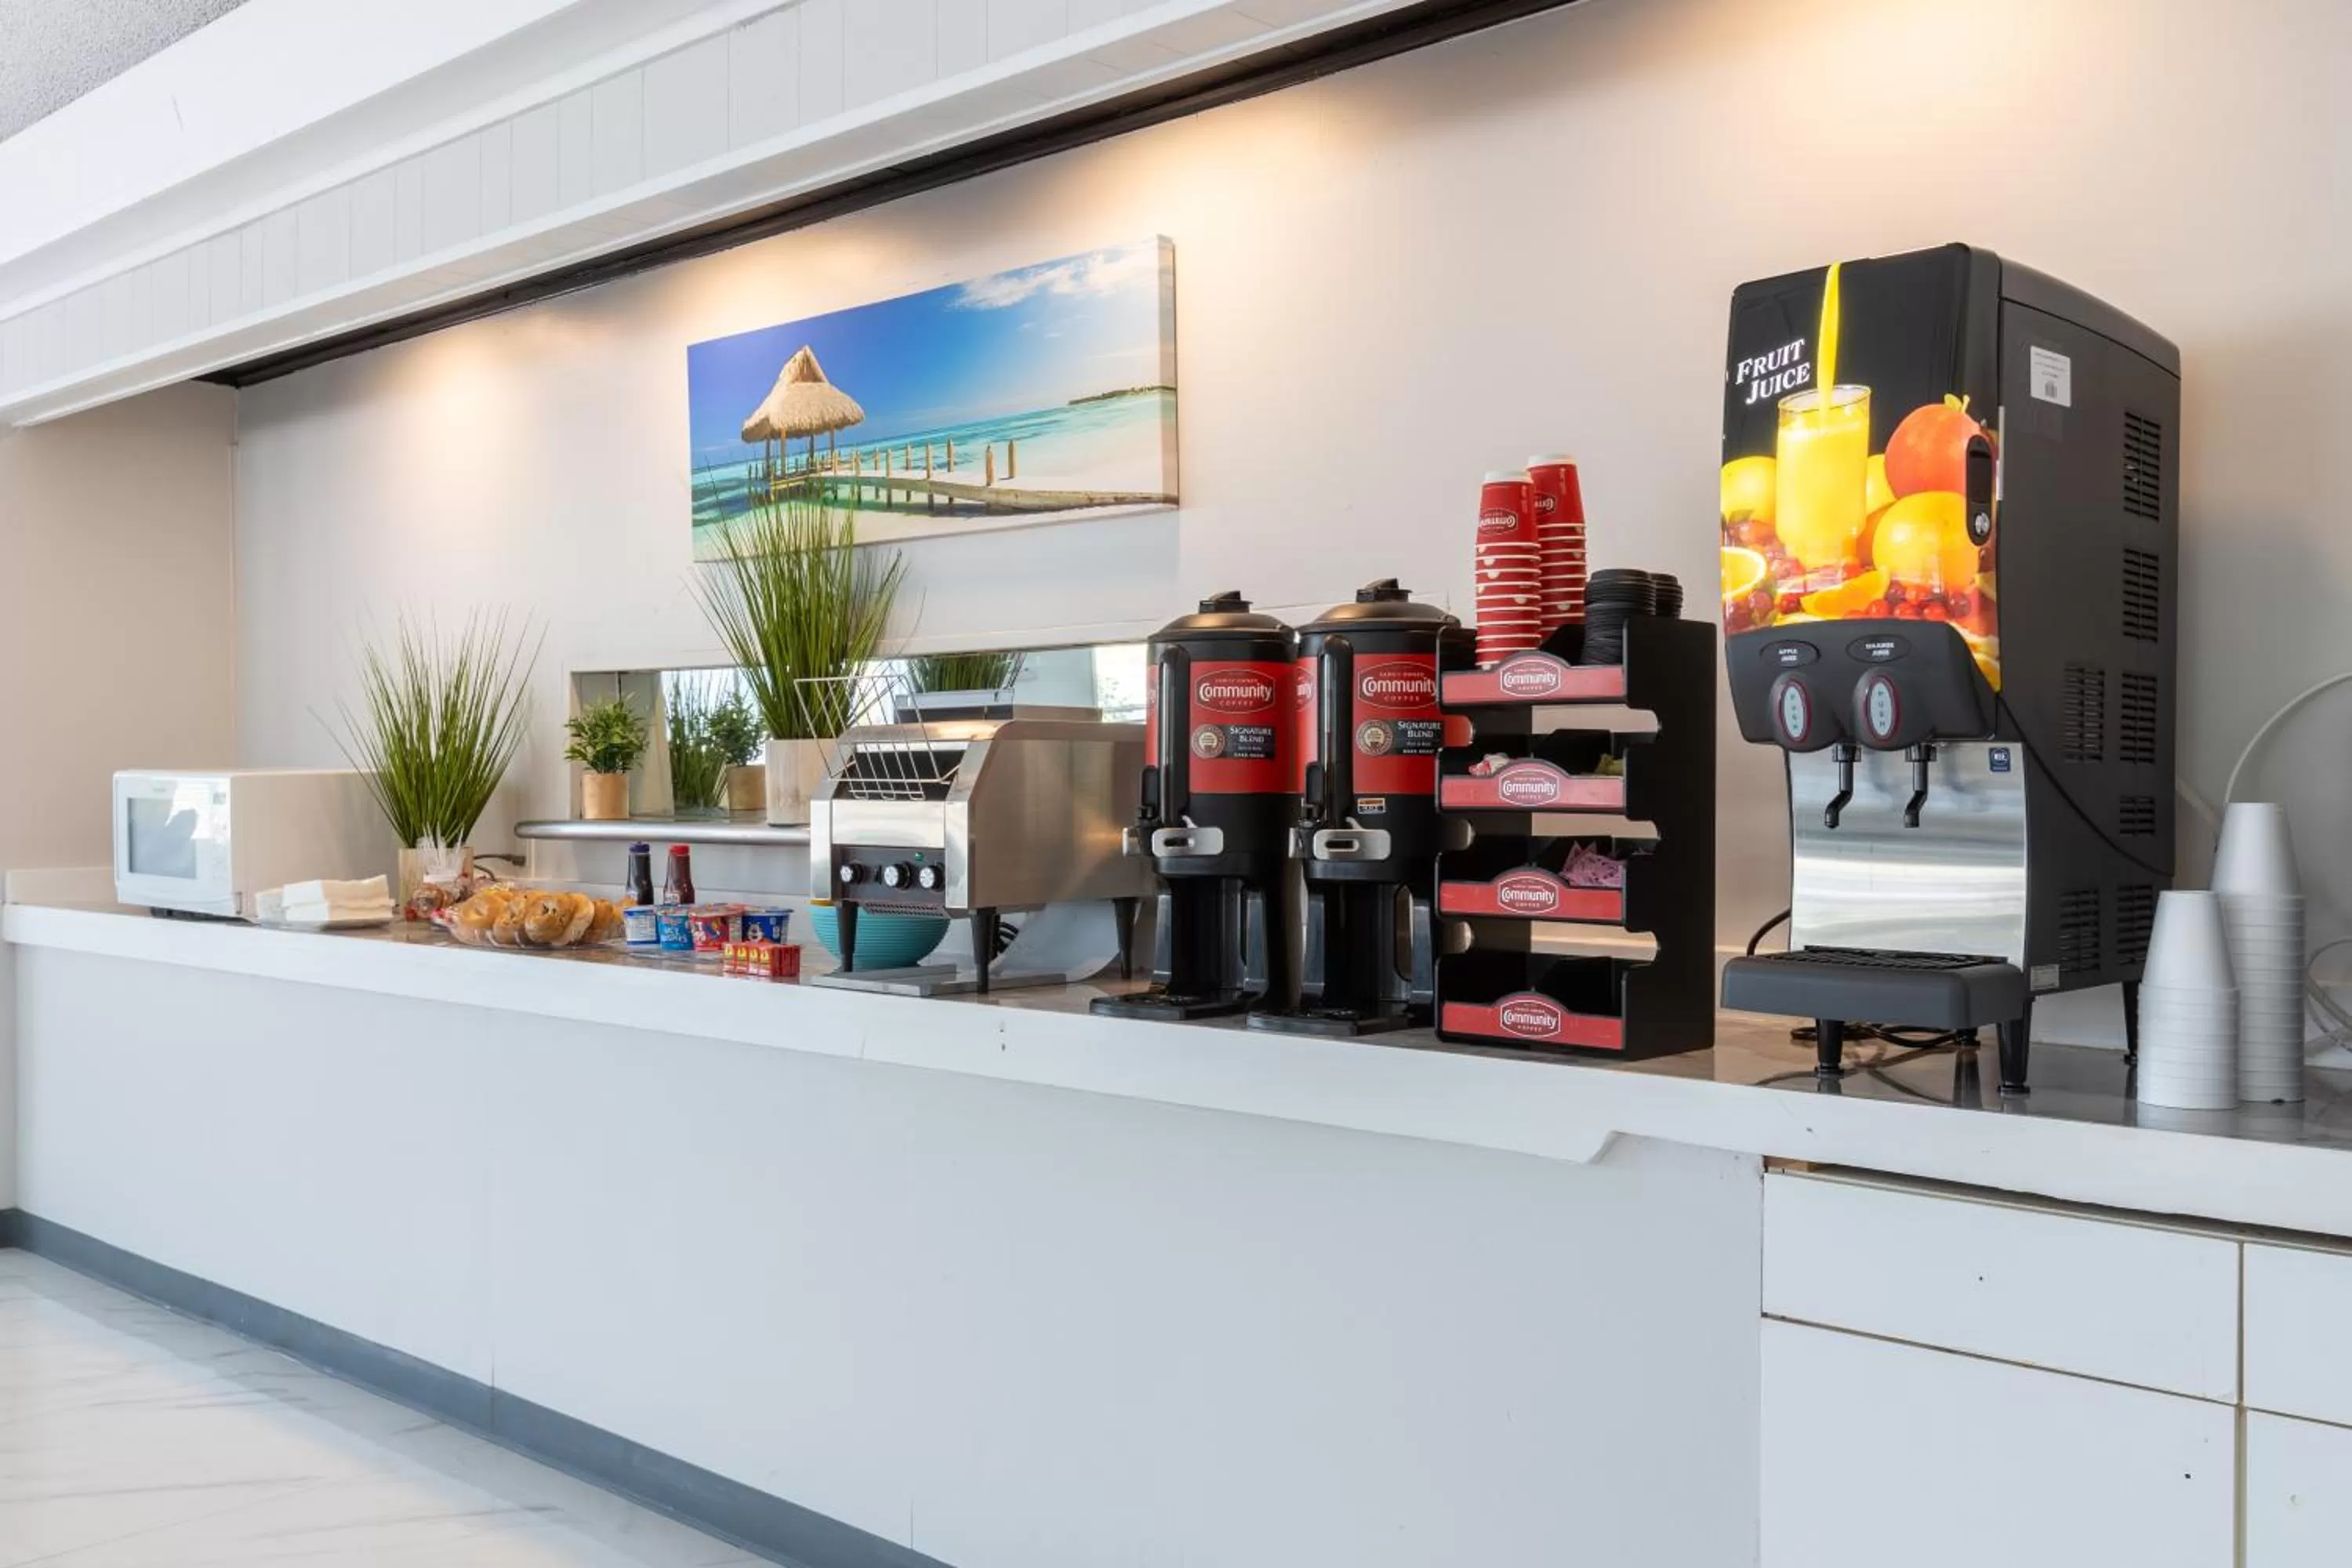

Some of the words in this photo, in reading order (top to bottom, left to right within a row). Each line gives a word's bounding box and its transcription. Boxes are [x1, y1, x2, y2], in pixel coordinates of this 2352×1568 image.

[1735, 339, 1806, 385] FRUIT
[1745, 361, 1810, 405] JUICE
[1363, 677, 1437, 697] Community
[1504, 671, 1556, 688] Community
[1200, 683, 1272, 702] Community
[1229, 727, 1272, 735] SIGNATURE
[1397, 720, 1442, 730] SIGNATURE
[1503, 781, 1555, 796] Community
[1501, 887, 1554, 905] Community
[1504, 1009, 1557, 1029] Community
